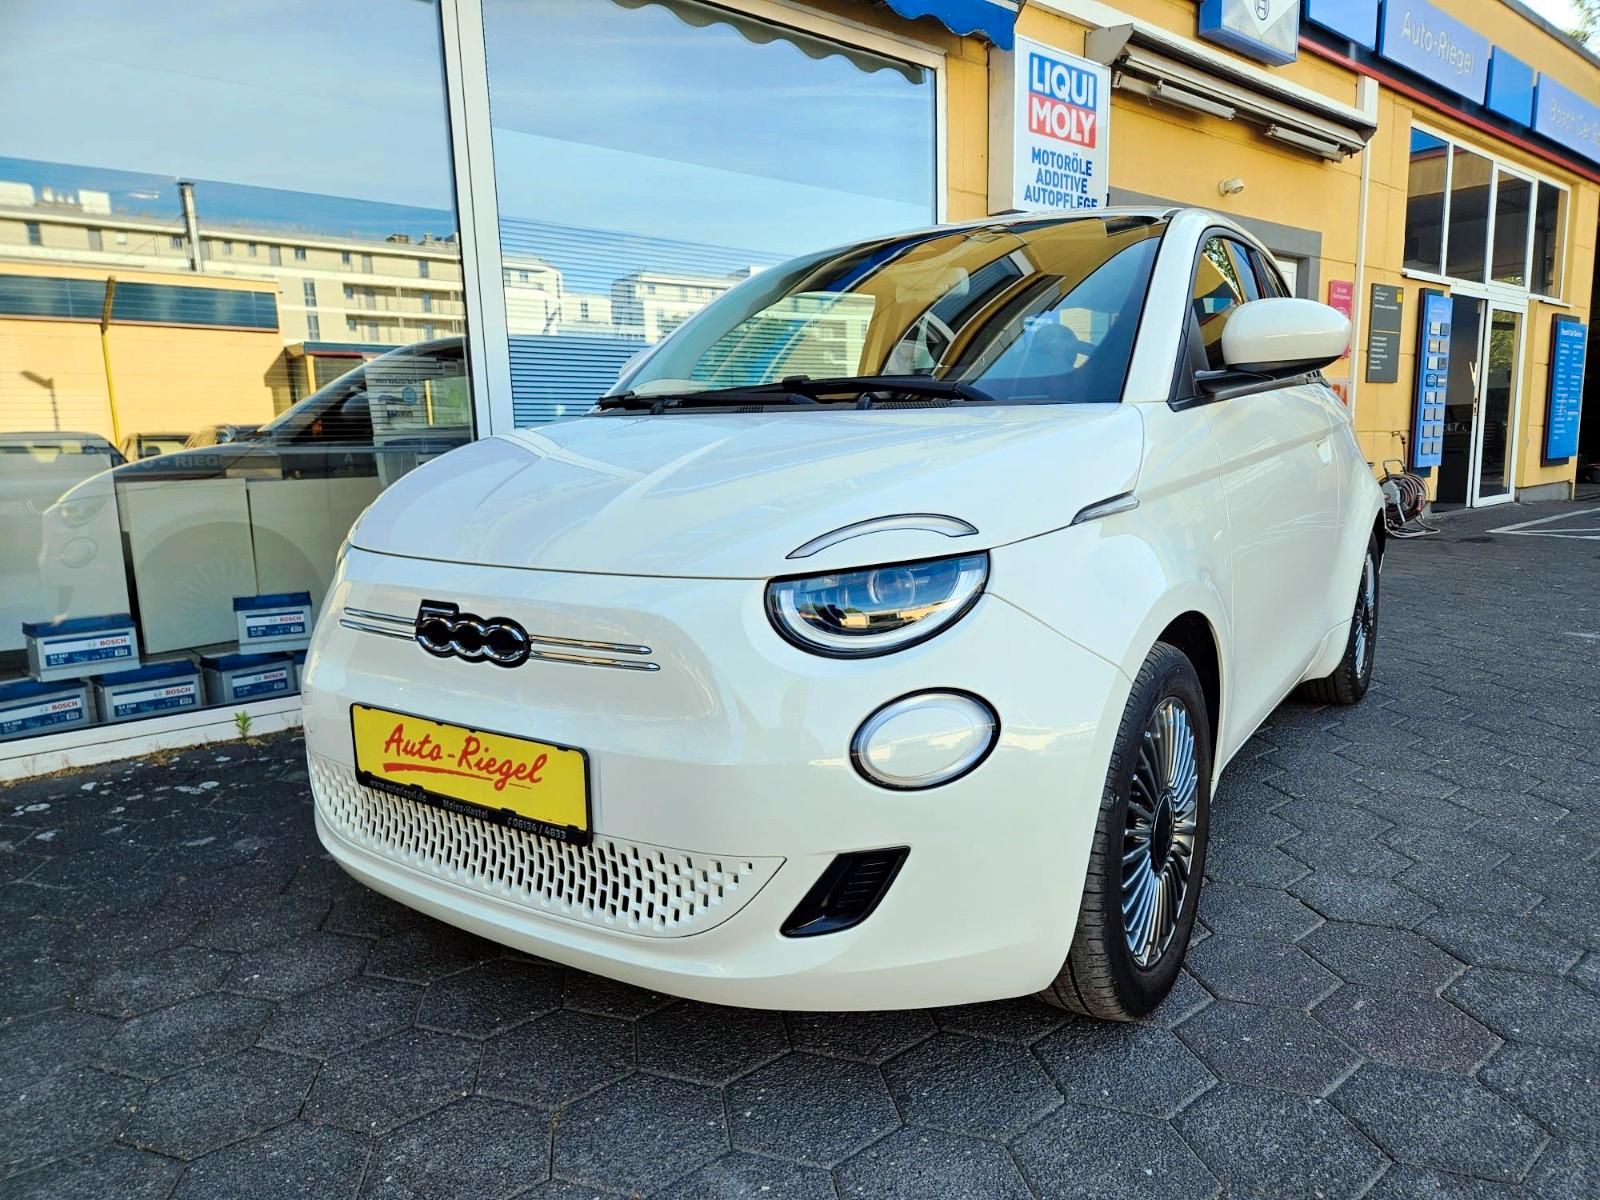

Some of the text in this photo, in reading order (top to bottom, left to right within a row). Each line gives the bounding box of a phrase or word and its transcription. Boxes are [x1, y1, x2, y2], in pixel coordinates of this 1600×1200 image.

[1032, 57, 1094, 108] LIQUI
[1031, 97, 1095, 144] MOLY
[1031, 146, 1092, 177] MOTORÖLE
[1036, 167, 1088, 194] ADDITIVE
[280, 615, 302, 623] BOSCH
[415, 599, 532, 669] 500
[100, 637, 127, 647] BOSCH
[264, 672, 284, 681] BOSCH
[165, 687, 191, 696] BOSCH
[52, 700, 78, 711] BOSCH
[544, 826, 567, 840] 4833
